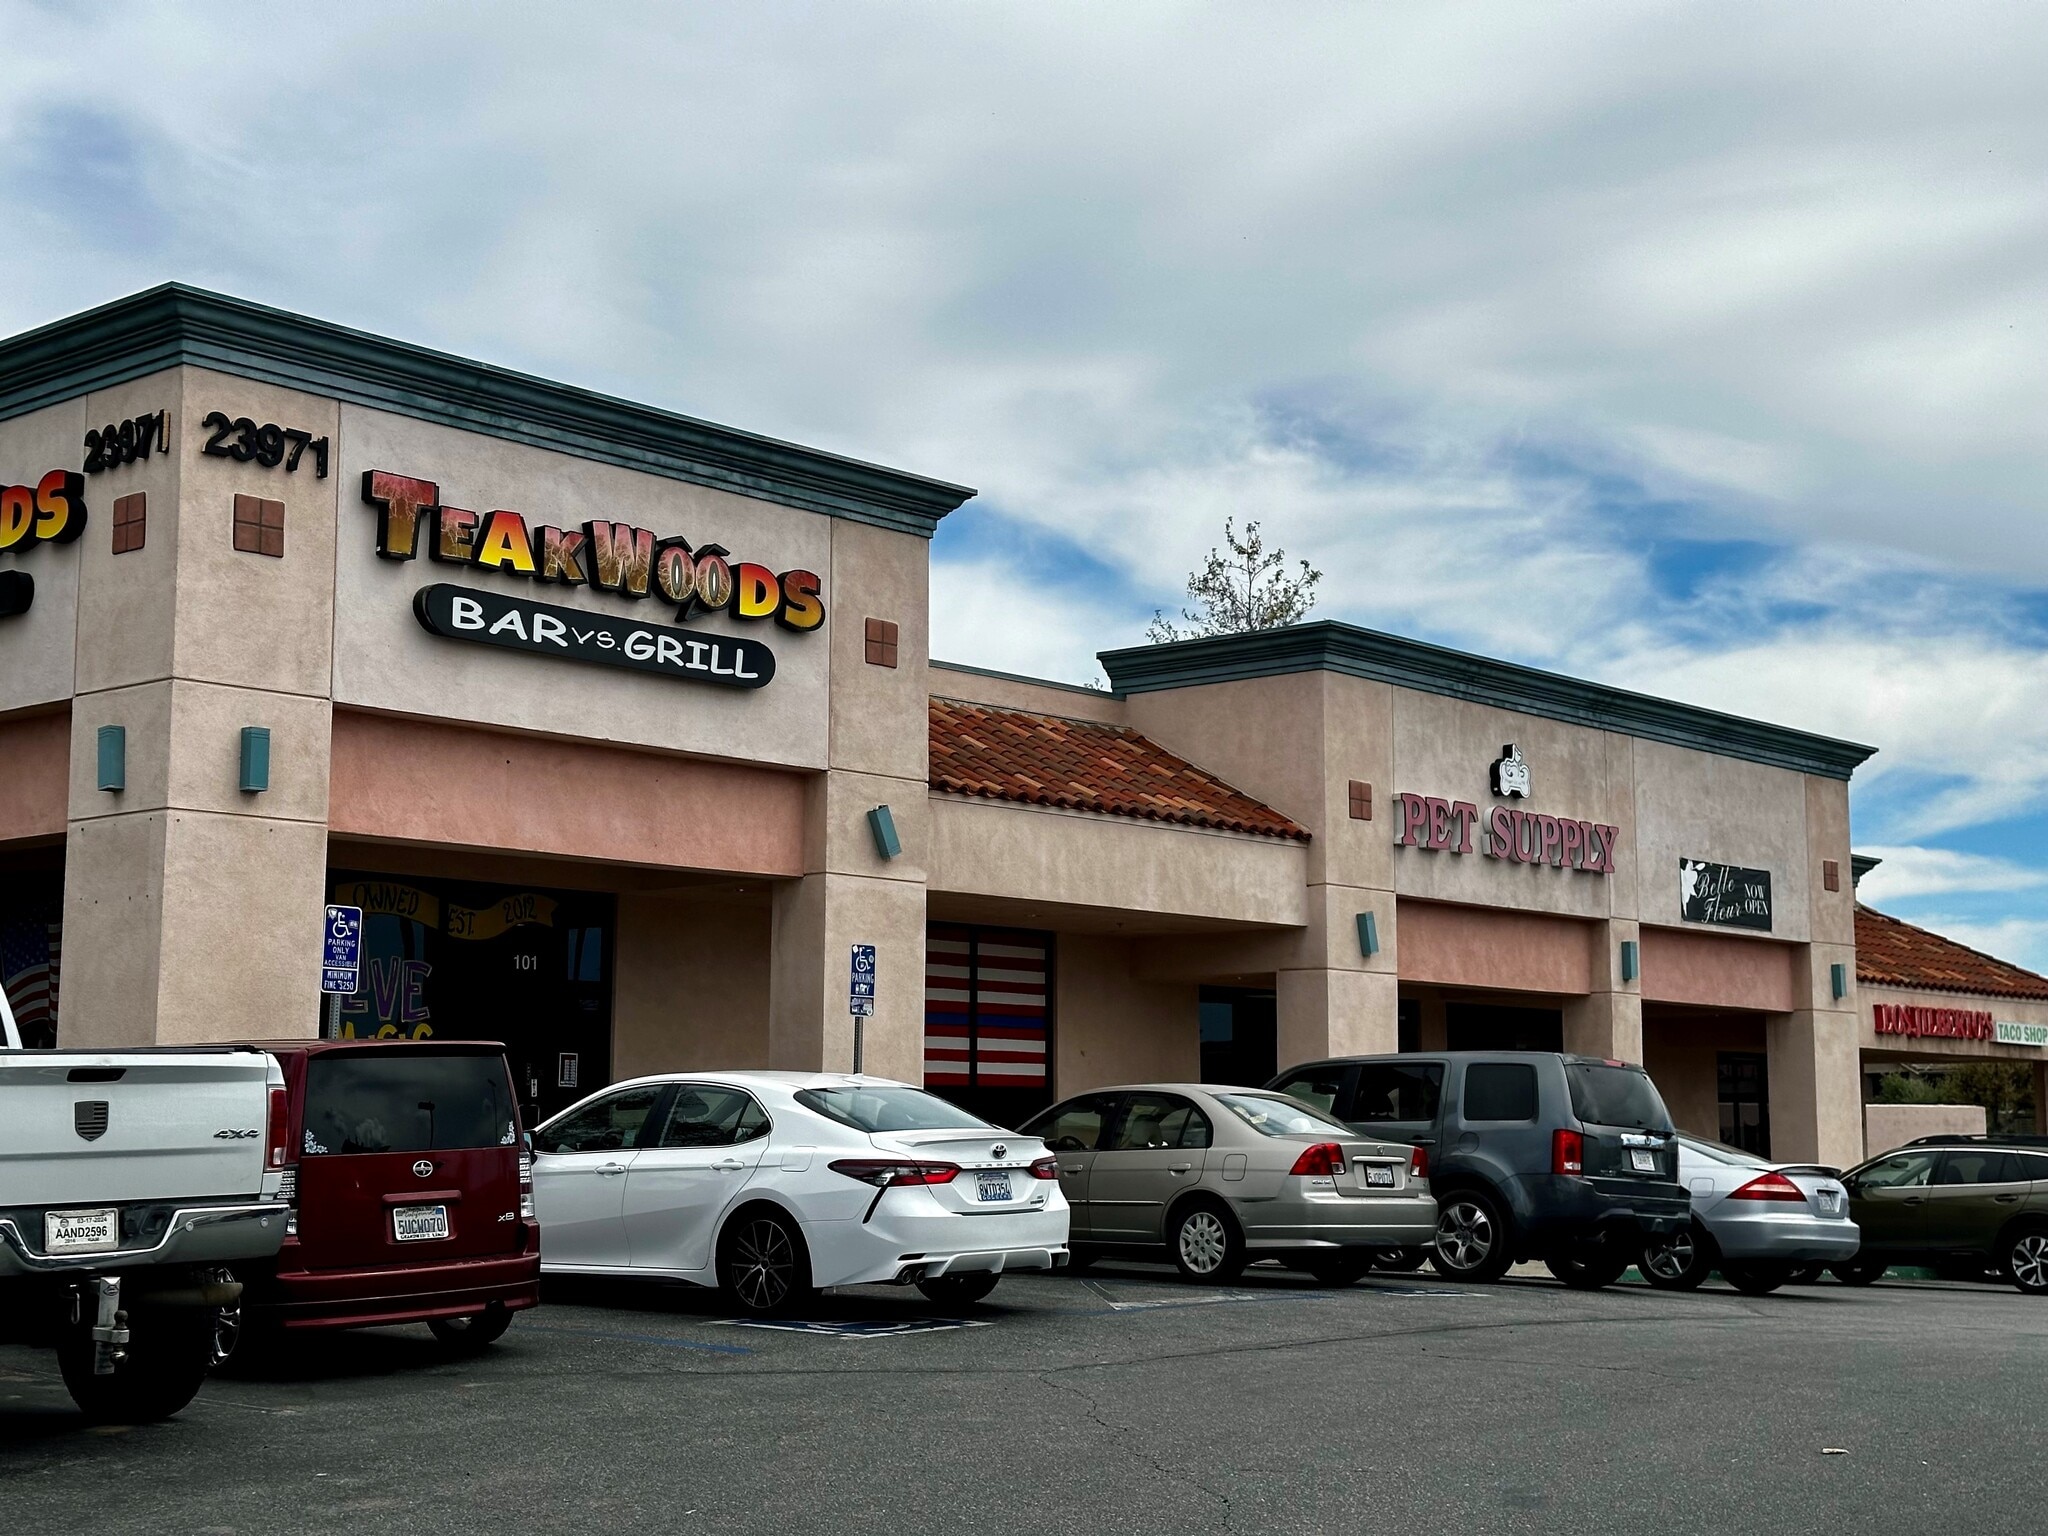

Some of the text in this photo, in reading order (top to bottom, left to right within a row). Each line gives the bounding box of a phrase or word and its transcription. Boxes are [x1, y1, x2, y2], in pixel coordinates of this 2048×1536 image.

[83, 409, 171, 473] 23971
[202, 411, 329, 478] 23971
[451, 597, 568, 647] BAR
[624, 631, 758, 679] GRILL
[1394, 793, 1619, 873] PET SUPPLY
[1697, 866, 1735, 899] Belle
[1744, 883, 1766, 899] NOW
[353, 885, 419, 915] OWNED
[1744, 899, 1769, 915] OPEN
[503, 895, 538, 924] 2012
[1702, 894, 1741, 924] Fleur
[327, 938, 356, 948] PARKING
[332, 946, 350, 955] ONLY
[324, 959, 357, 968] ACCESSIBLE
[513, 954, 537, 971] 101
[327, 970, 353, 981] MINIMUM
[851, 972, 875, 984] PARKING
[324, 980, 336, 990] FINE
[1997, 1023, 2048, 1043] TACO SHOP
[56, 1225, 108, 1239] AAND2596
